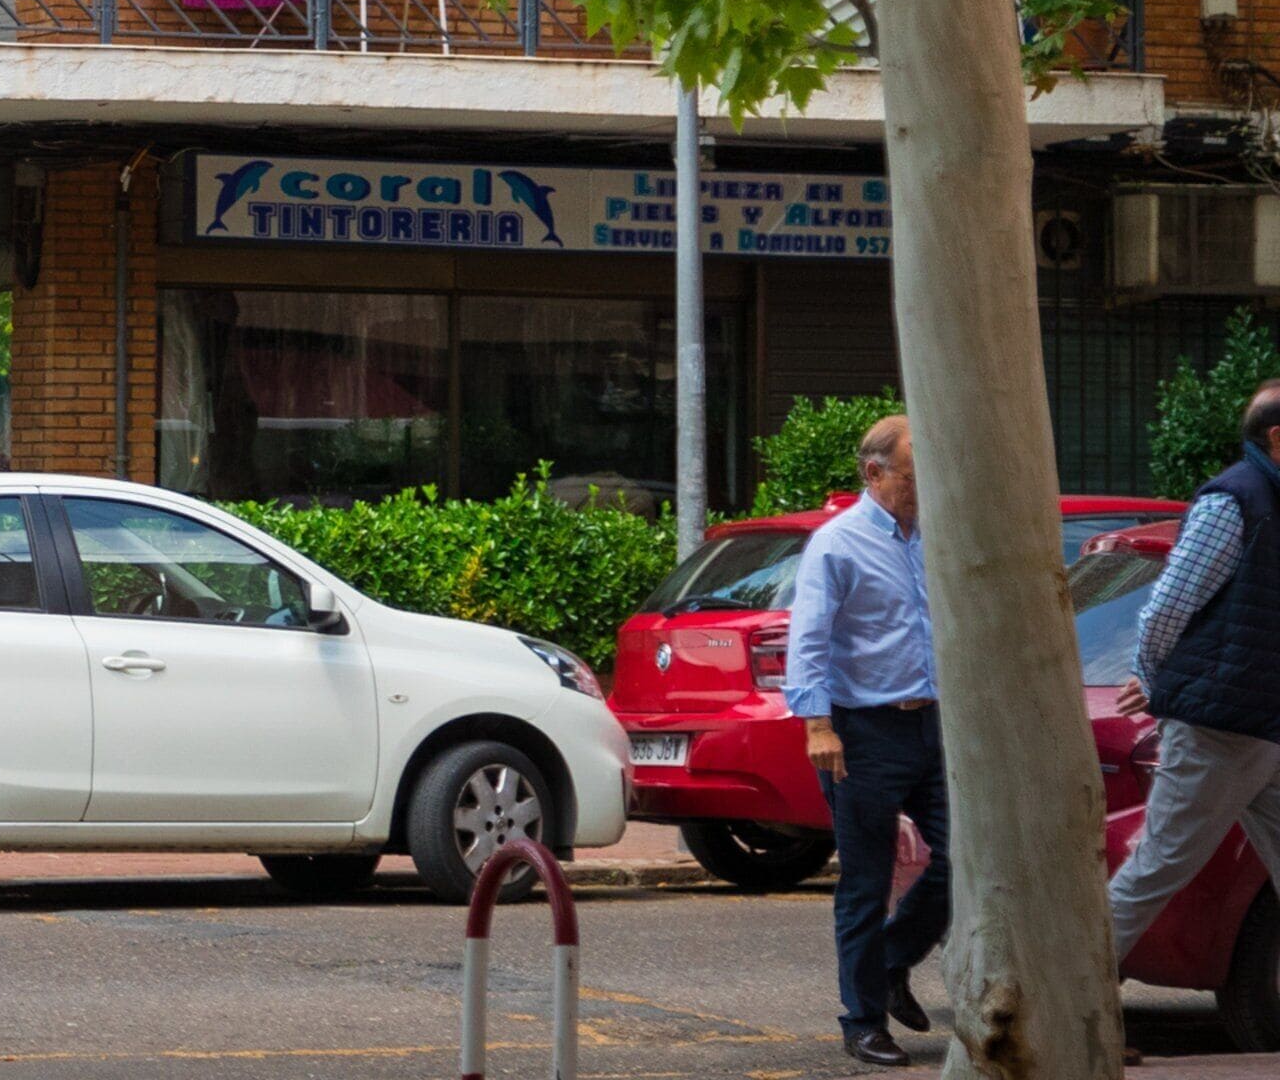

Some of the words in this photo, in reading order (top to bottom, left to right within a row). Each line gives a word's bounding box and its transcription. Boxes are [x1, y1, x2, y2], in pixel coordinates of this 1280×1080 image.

[280, 168, 491, 206] coral
[634, 173, 783, 202] LIIEZA
[806, 182, 844, 203] EN
[248, 201, 523, 247] TINTORERIA
[606, 196, 719, 225] PIELS
[742, 206, 763, 225] Y
[785, 203, 890, 228] ALFOM
[594, 223, 677, 249] SERVIC
[710, 231, 723, 251] A
[738, 228, 846, 254] DOMICILIO
[856, 235, 890, 254] 957
